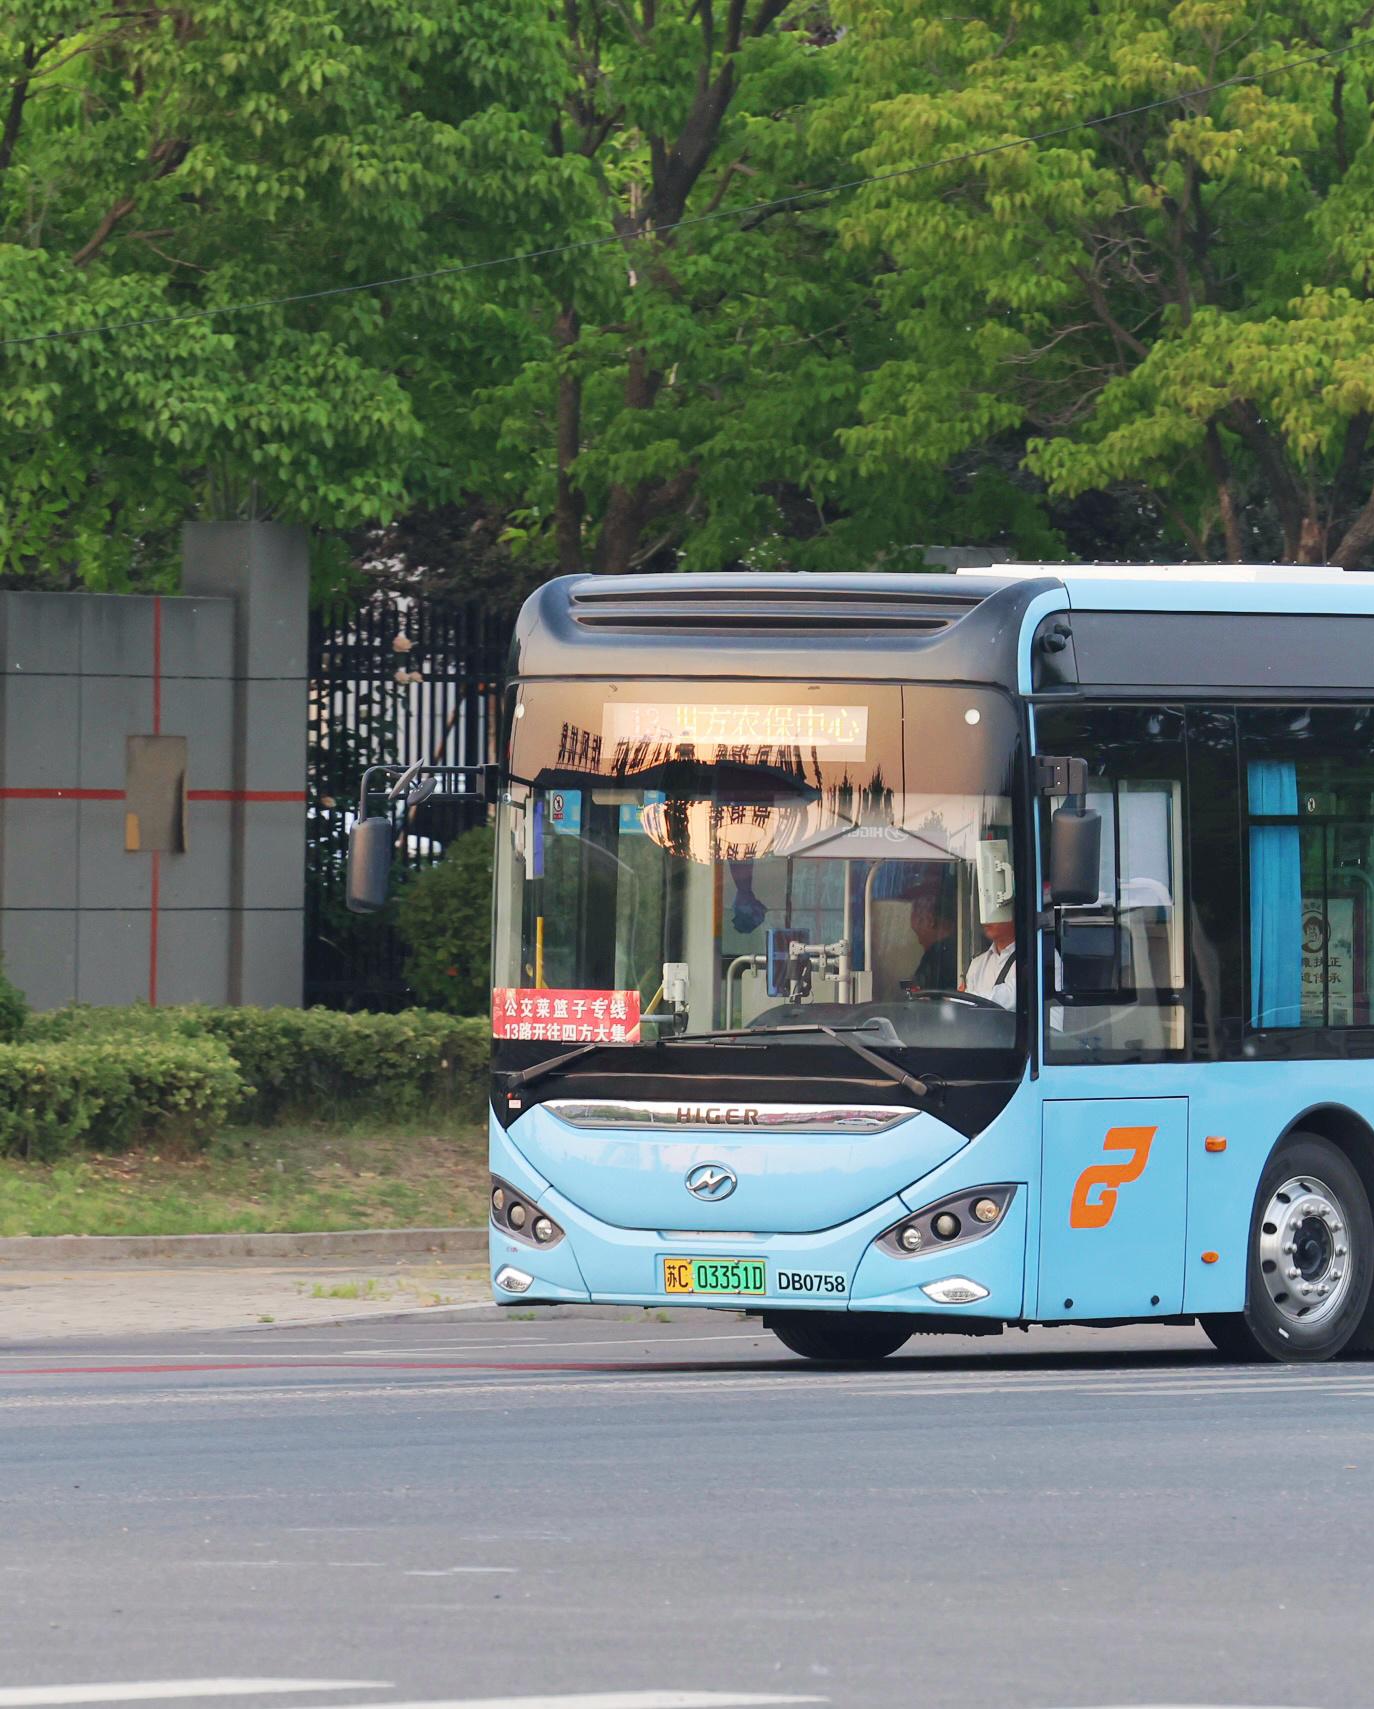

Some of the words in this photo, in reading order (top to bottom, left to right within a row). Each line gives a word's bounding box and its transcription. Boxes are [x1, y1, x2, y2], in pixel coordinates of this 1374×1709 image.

[504, 997, 628, 1020] 公交菜篮子专线
[504, 1023, 627, 1042] 13路开往四方大集
[677, 1107, 759, 1126] HIGER
[777, 1272, 847, 1293] DB0758
